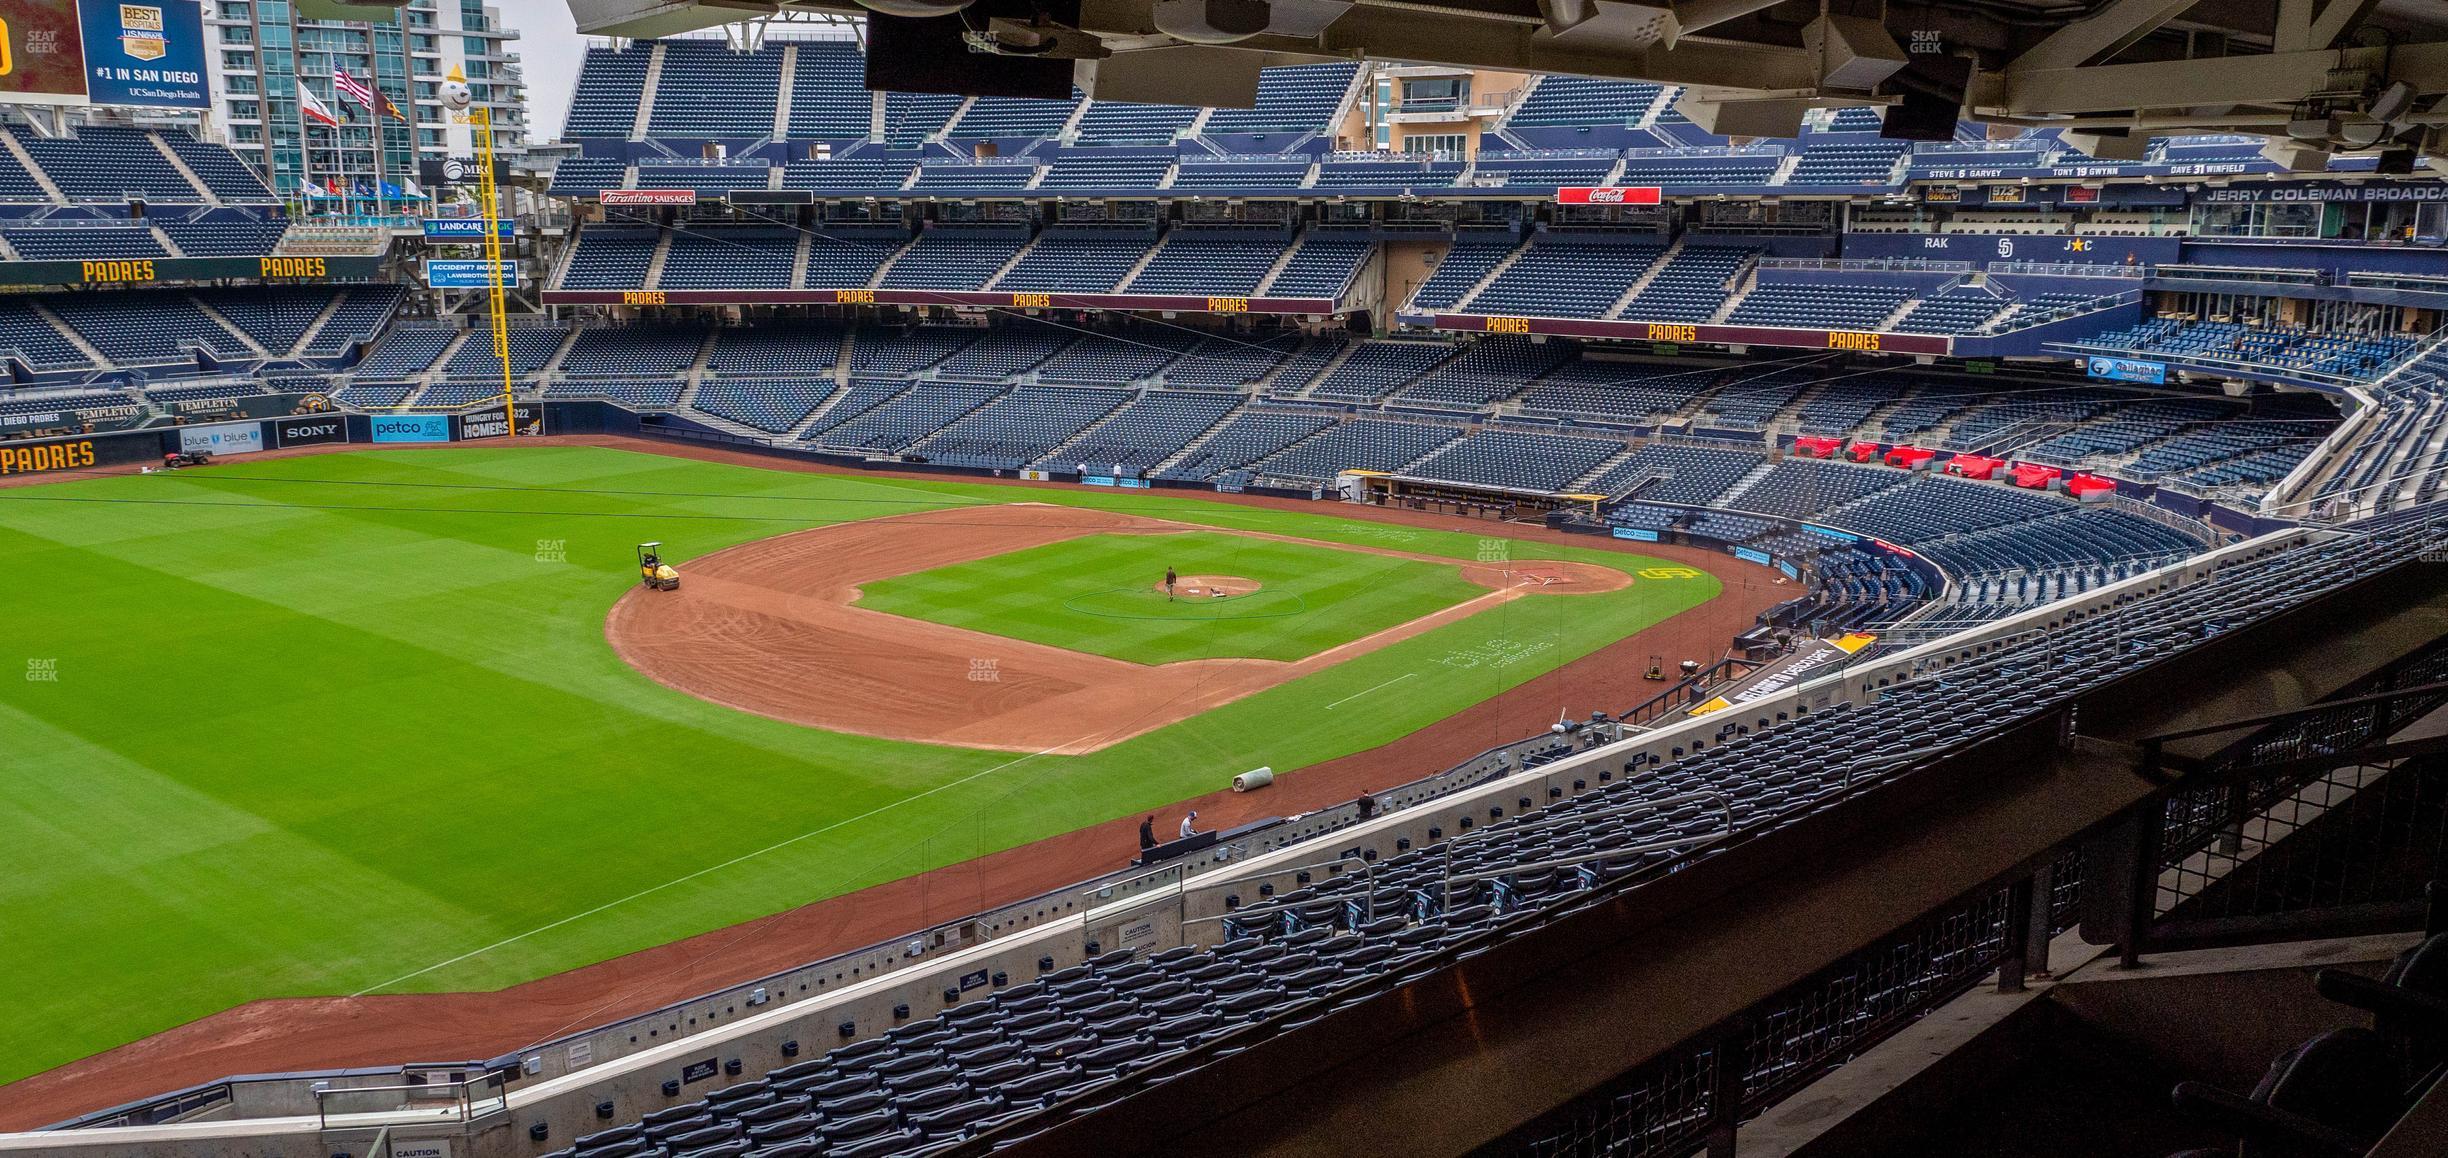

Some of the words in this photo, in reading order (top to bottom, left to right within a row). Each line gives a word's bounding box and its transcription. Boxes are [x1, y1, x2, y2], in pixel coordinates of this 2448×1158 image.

[124, 8, 160, 20] BEST
[124, 20, 161, 29] HOSPITALS
[96, 67, 112, 80] #1
[116, 68, 130, 81] IN
[134, 69, 159, 82] SAN
[163, 70, 199, 84] DIEGO
[129, 88, 142, 96] UC
[142, 88, 156, 97] San
[156, 89, 177, 100] Diego
[178, 90, 200, 99] Health
[1929, 170, 1955, 178] STEVE
[1958, 169, 1966, 178] 6
[1969, 169, 2001, 177] GARVEY
[2053, 168, 2073, 176] TONY
[2076, 167, 2087, 177] 19
[2089, 168, 2118, 176] GWYNN
[2170, 165, 2191, 174] DAVE
[2193, 164, 2205, 174] 31
[2206, 164, 2245, 173] WINFIELD
[603, 191, 653, 203] Tarantino
[654, 195, 693, 203] SAUSAGES
[2207, 189, 2263, 201] JERRY
[2271, 188, 2357, 201] COLEMAN
[1925, 238, 1948, 249] RAK
[82, 260, 155, 282] PADRES
[260, 257, 326, 277] PADRES
[624, 291, 665, 305] PADRES
[837, 290, 875, 303] PADRES
[1013, 293, 1050, 307] PADRES
[1208, 297, 1248, 312] PADRES
[1486, 317, 1529, 334] PADRES
[1648, 323, 1696, 342] PADRES
[1828, 332, 1880, 351] PADRES
[4, 415, 27, 426] DIEGO
[29, 413, 60, 424] PADRES
[465, 412, 491, 423] HUNGRY
[492, 411, 505, 420] FOR
[514, 409, 530, 418] 322
[287, 424, 337, 438] SONY
[376, 421, 421, 436] petco
[463, 422, 509, 438] HOMERS
[184, 436, 209, 446] blue
[224, 432, 248, 442] blue
[0, 441, 95, 475] PADRES
[1615, 528, 1635, 537] petco
[1125, 923, 1151, 936] CAUTION
[396, 1149, 440, 1157] CAUTION
